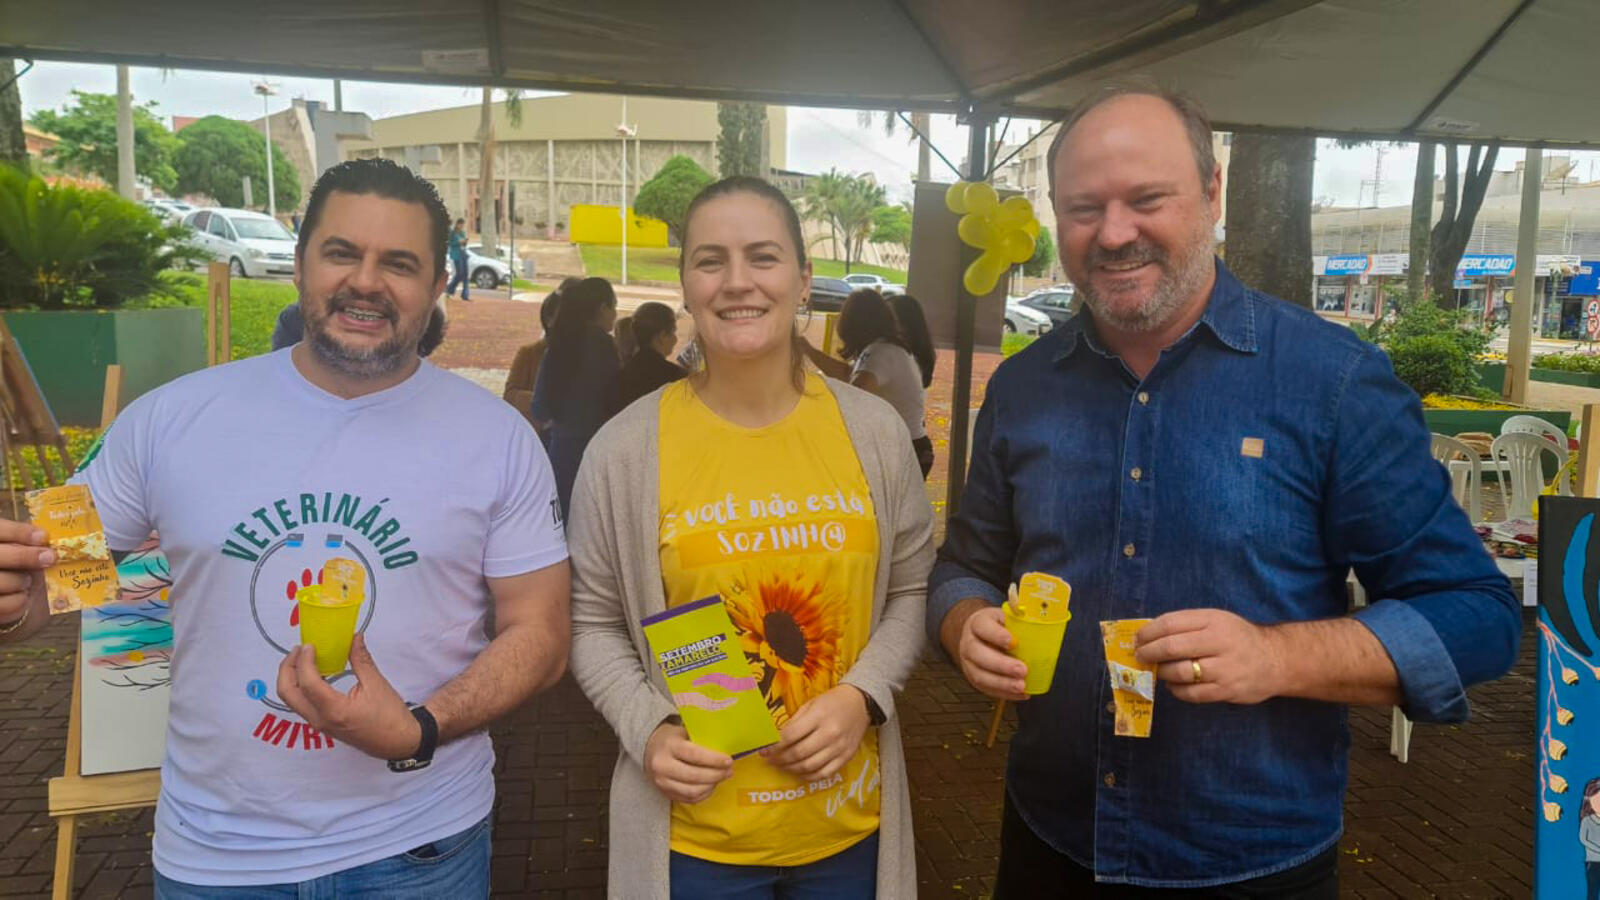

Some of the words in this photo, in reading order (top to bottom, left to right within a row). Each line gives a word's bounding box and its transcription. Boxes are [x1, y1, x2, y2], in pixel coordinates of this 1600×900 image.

[221, 491, 419, 570] VETERINÁRIO
[660, 635, 722, 661] SETEMBRO
[747, 786, 806, 803] TODOS
